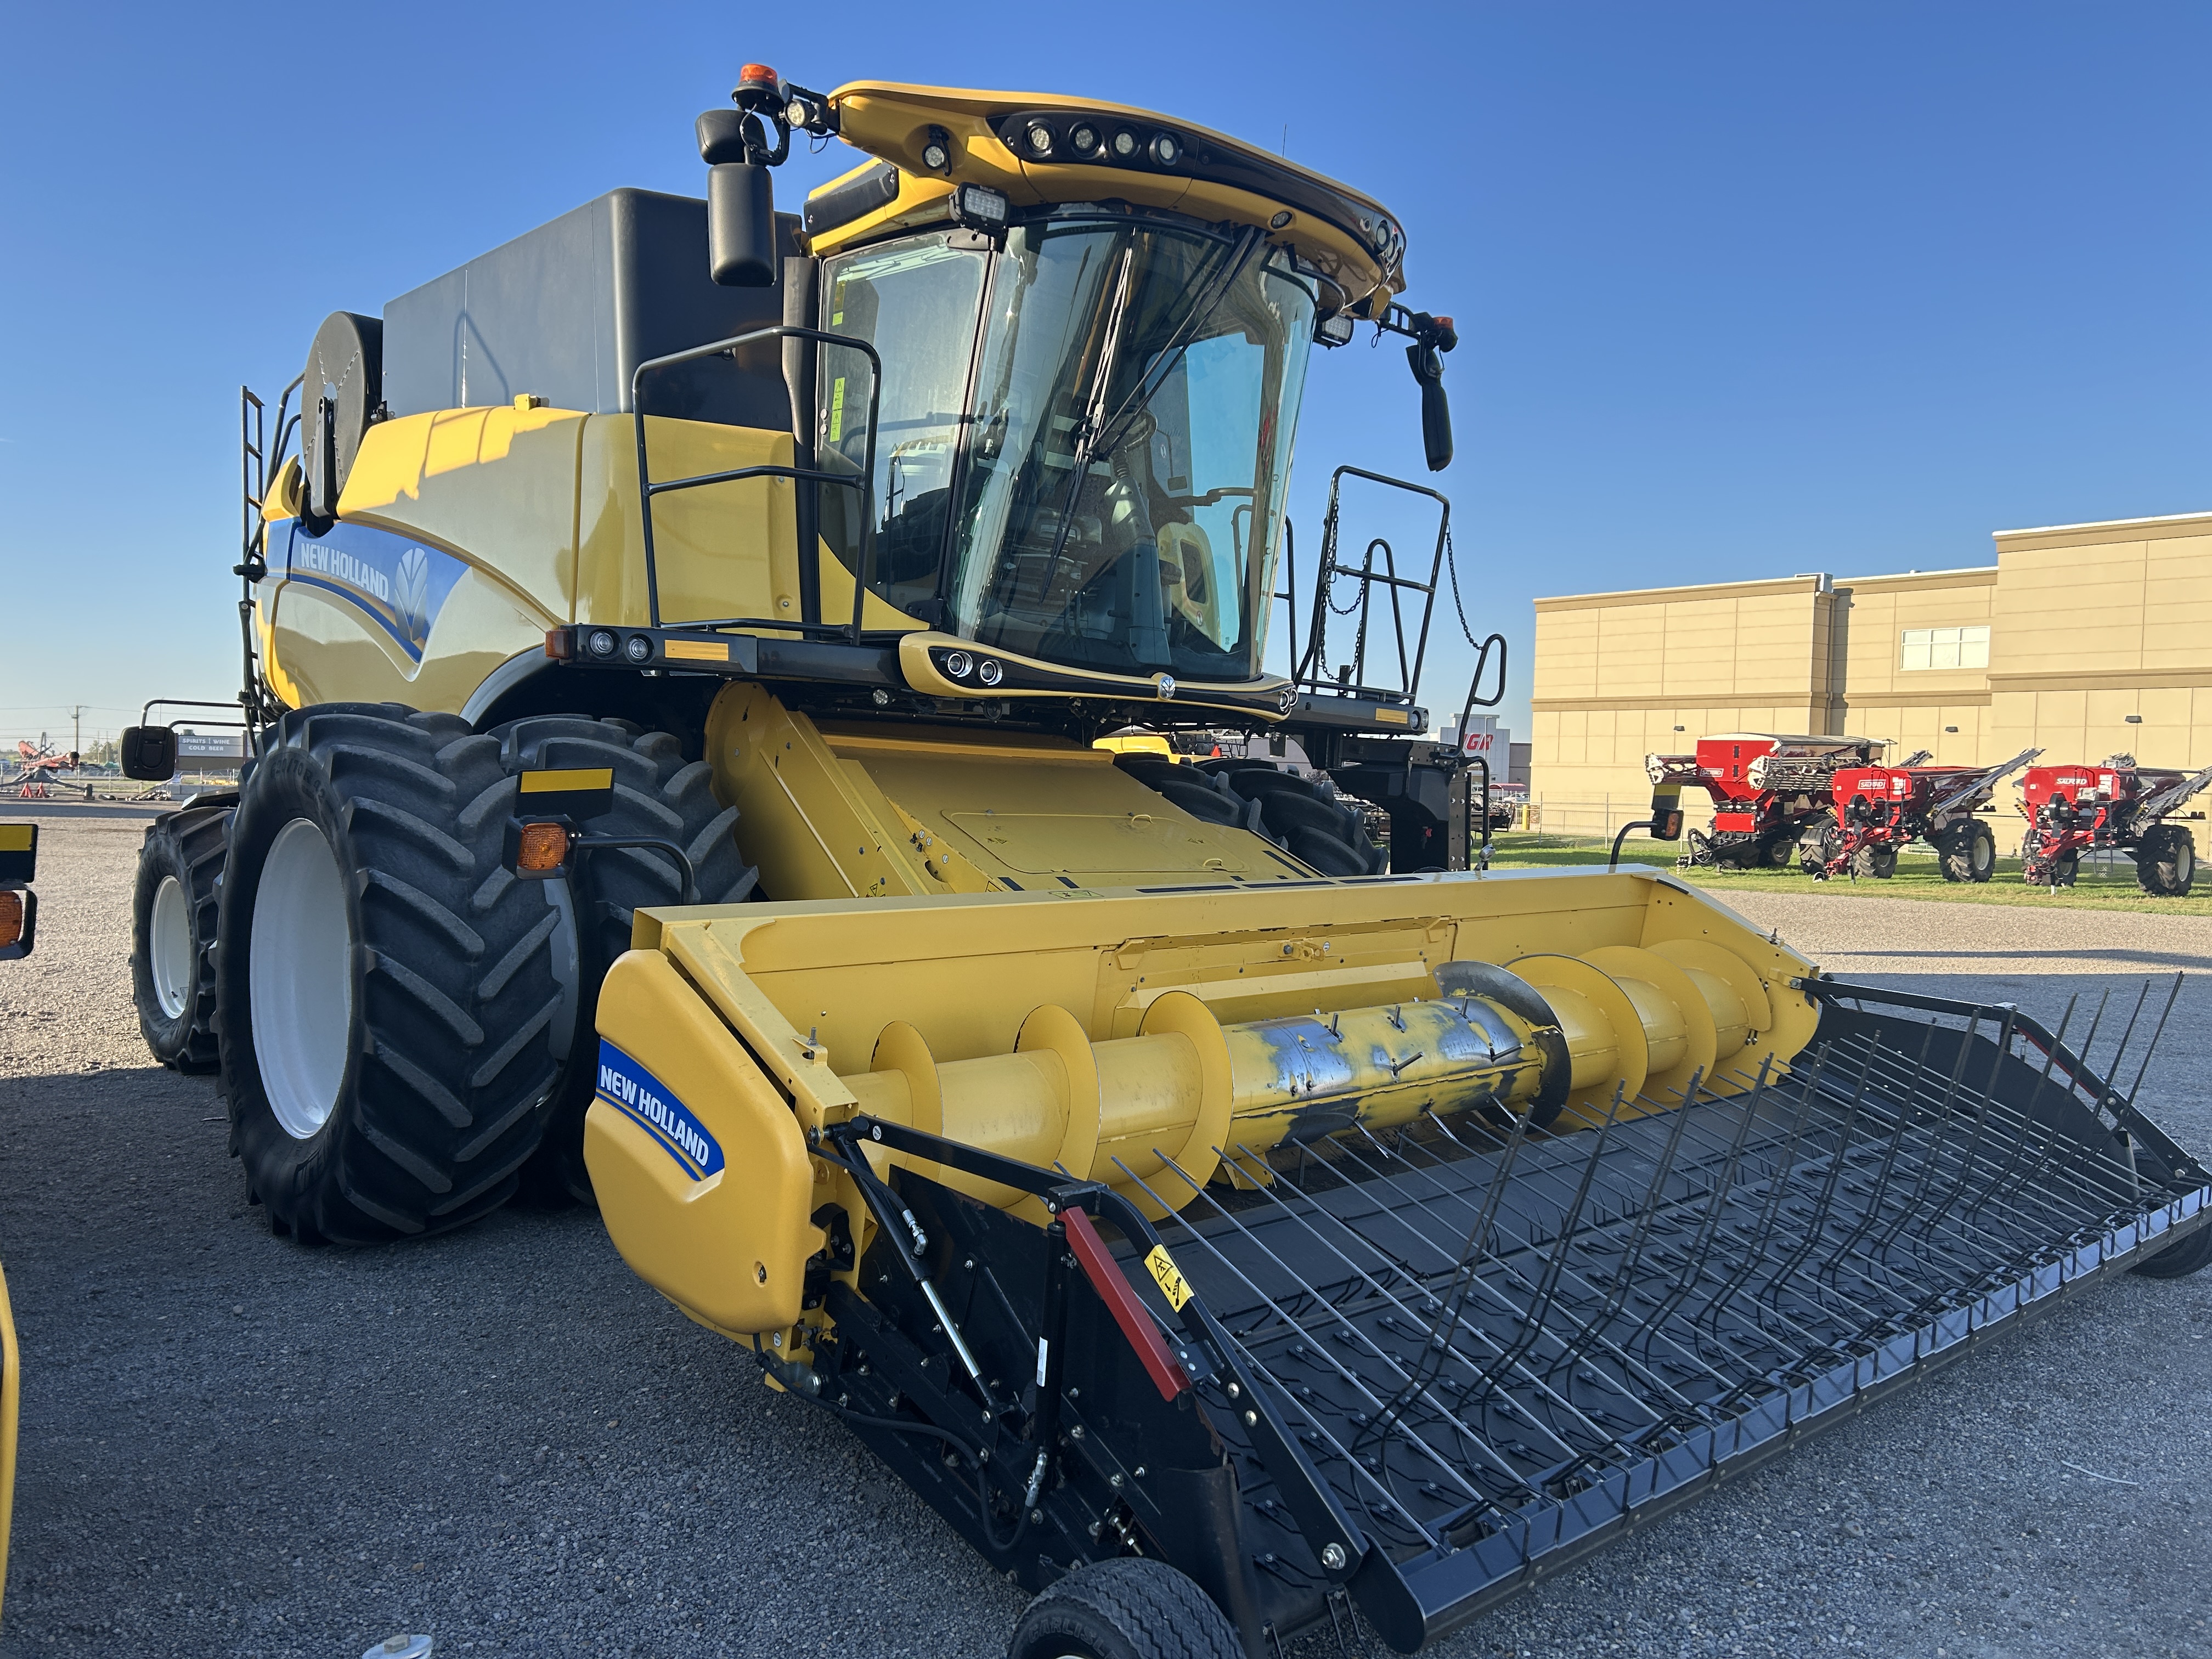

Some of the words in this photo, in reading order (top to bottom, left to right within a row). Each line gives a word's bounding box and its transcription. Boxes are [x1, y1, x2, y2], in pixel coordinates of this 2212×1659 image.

[301, 543, 329, 572] NEW
[330, 548, 389, 602] HOLLAND
[600, 1064, 637, 1105] NEW
[638, 1087, 709, 1166] HOLLAND
